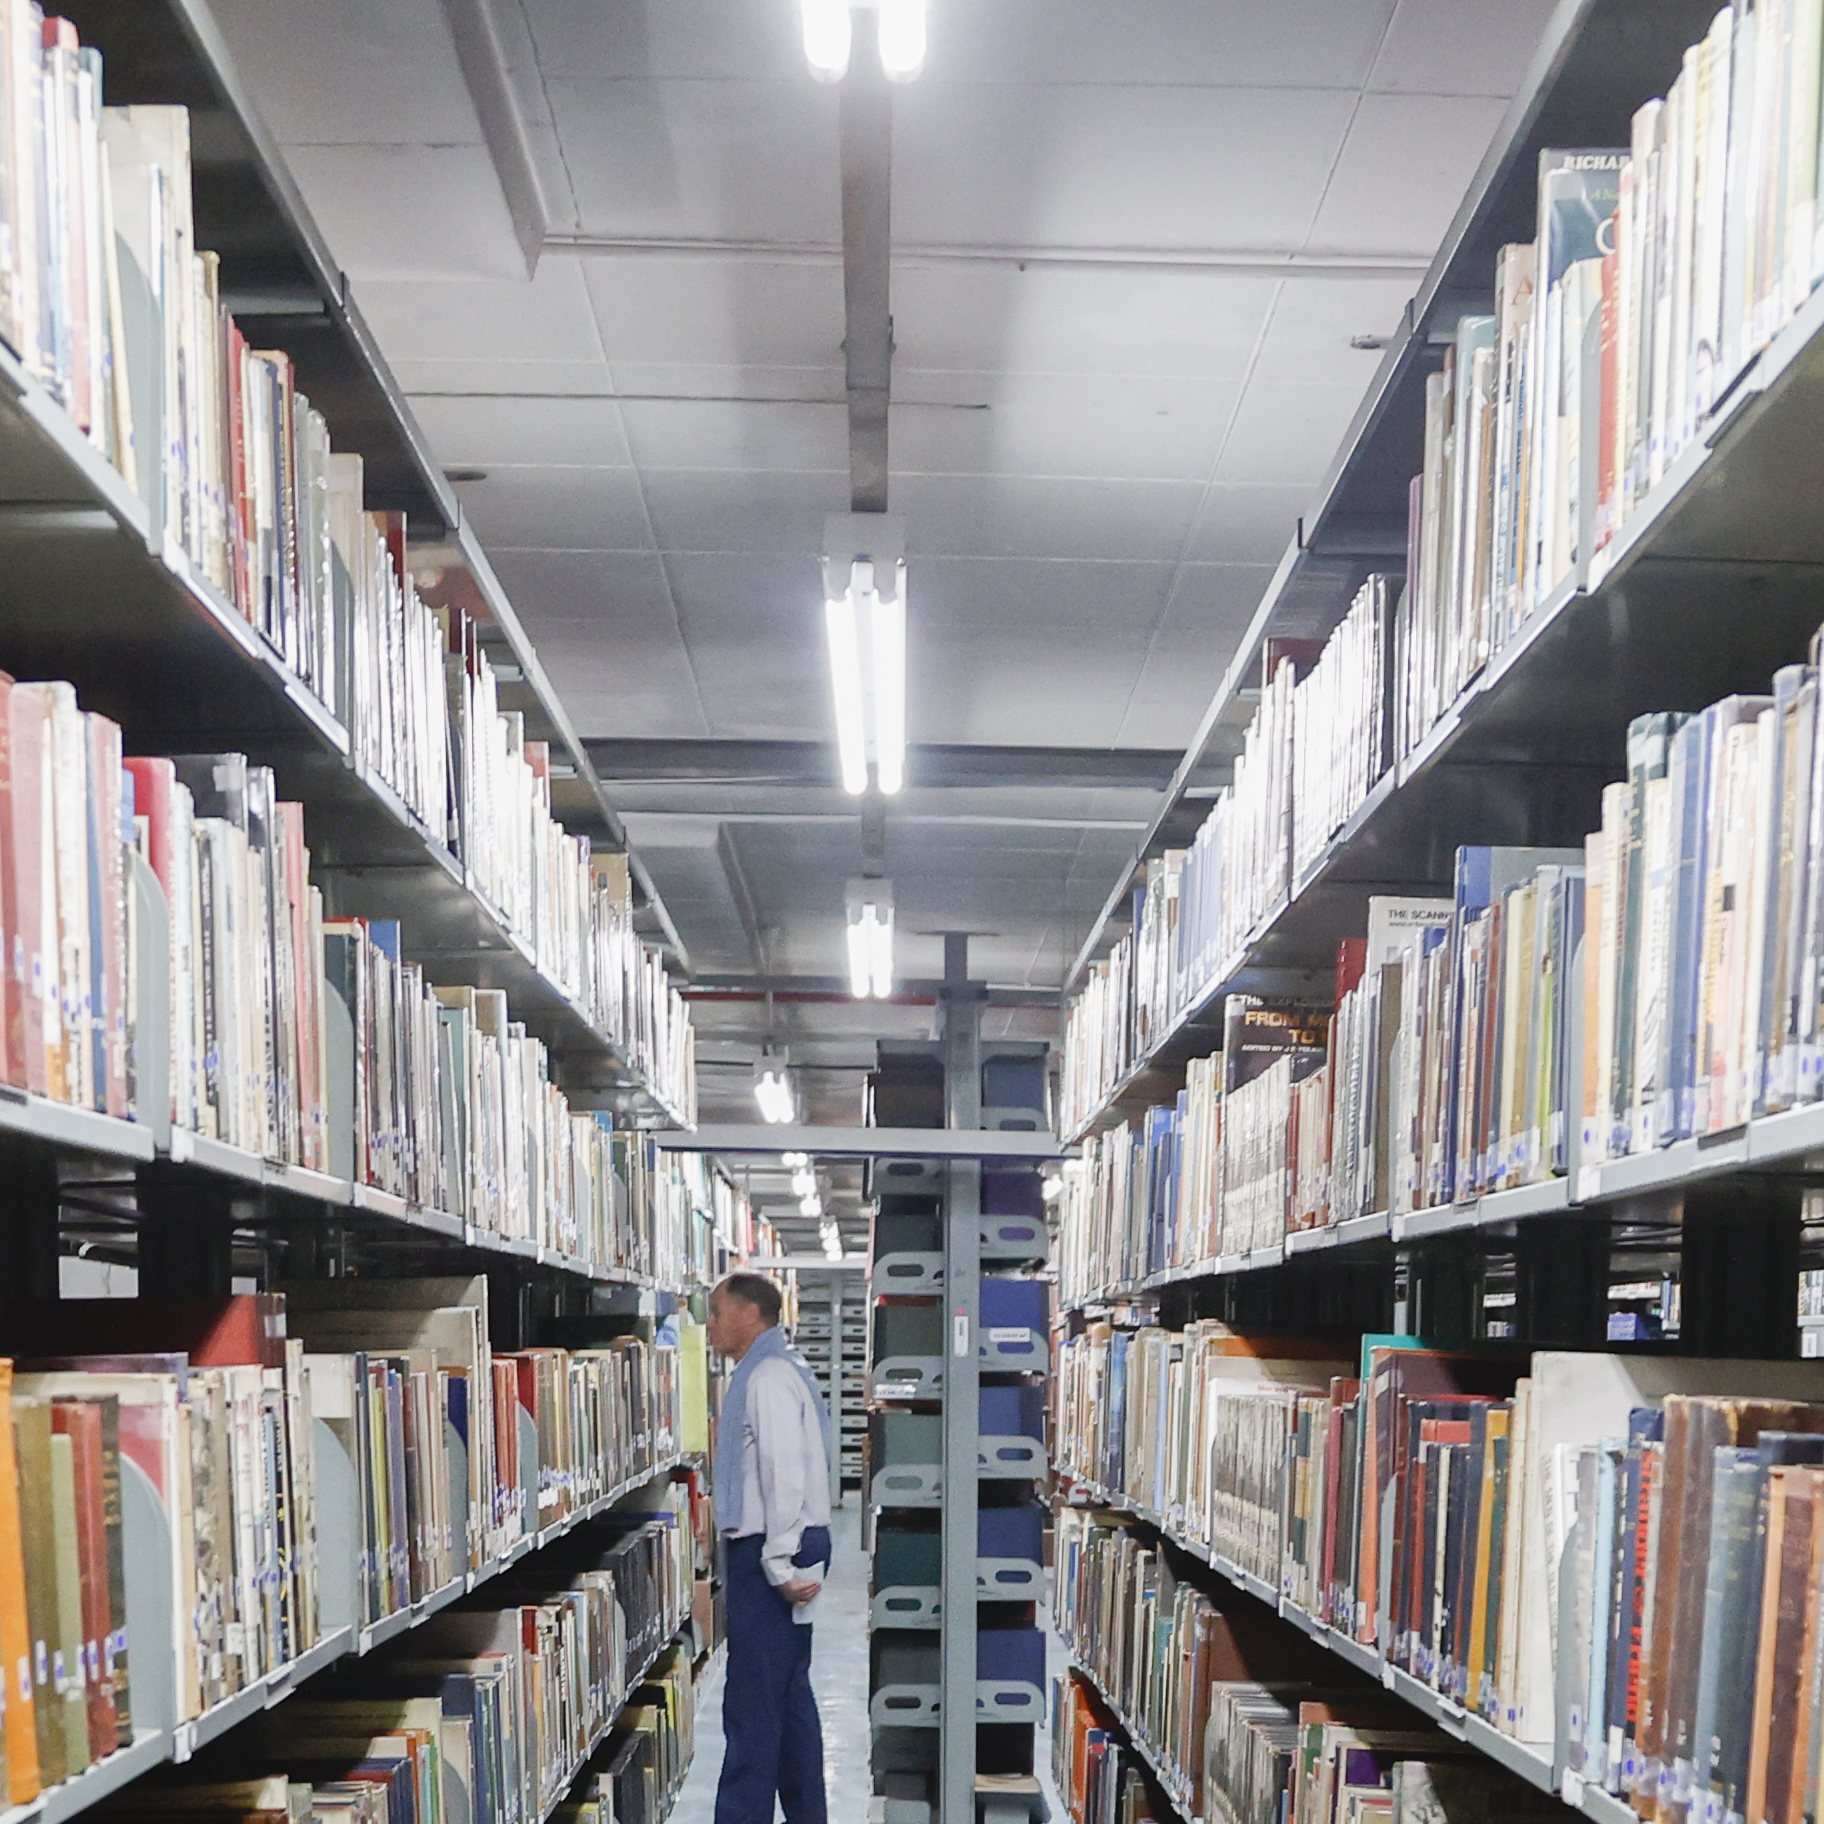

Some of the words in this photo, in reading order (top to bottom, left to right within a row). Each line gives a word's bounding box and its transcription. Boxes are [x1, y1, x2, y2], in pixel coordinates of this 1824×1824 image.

[1388, 909, 1407, 919] THE
[1244, 1010, 1301, 1027] FROM
[1288, 1028, 1316, 1044] TO
